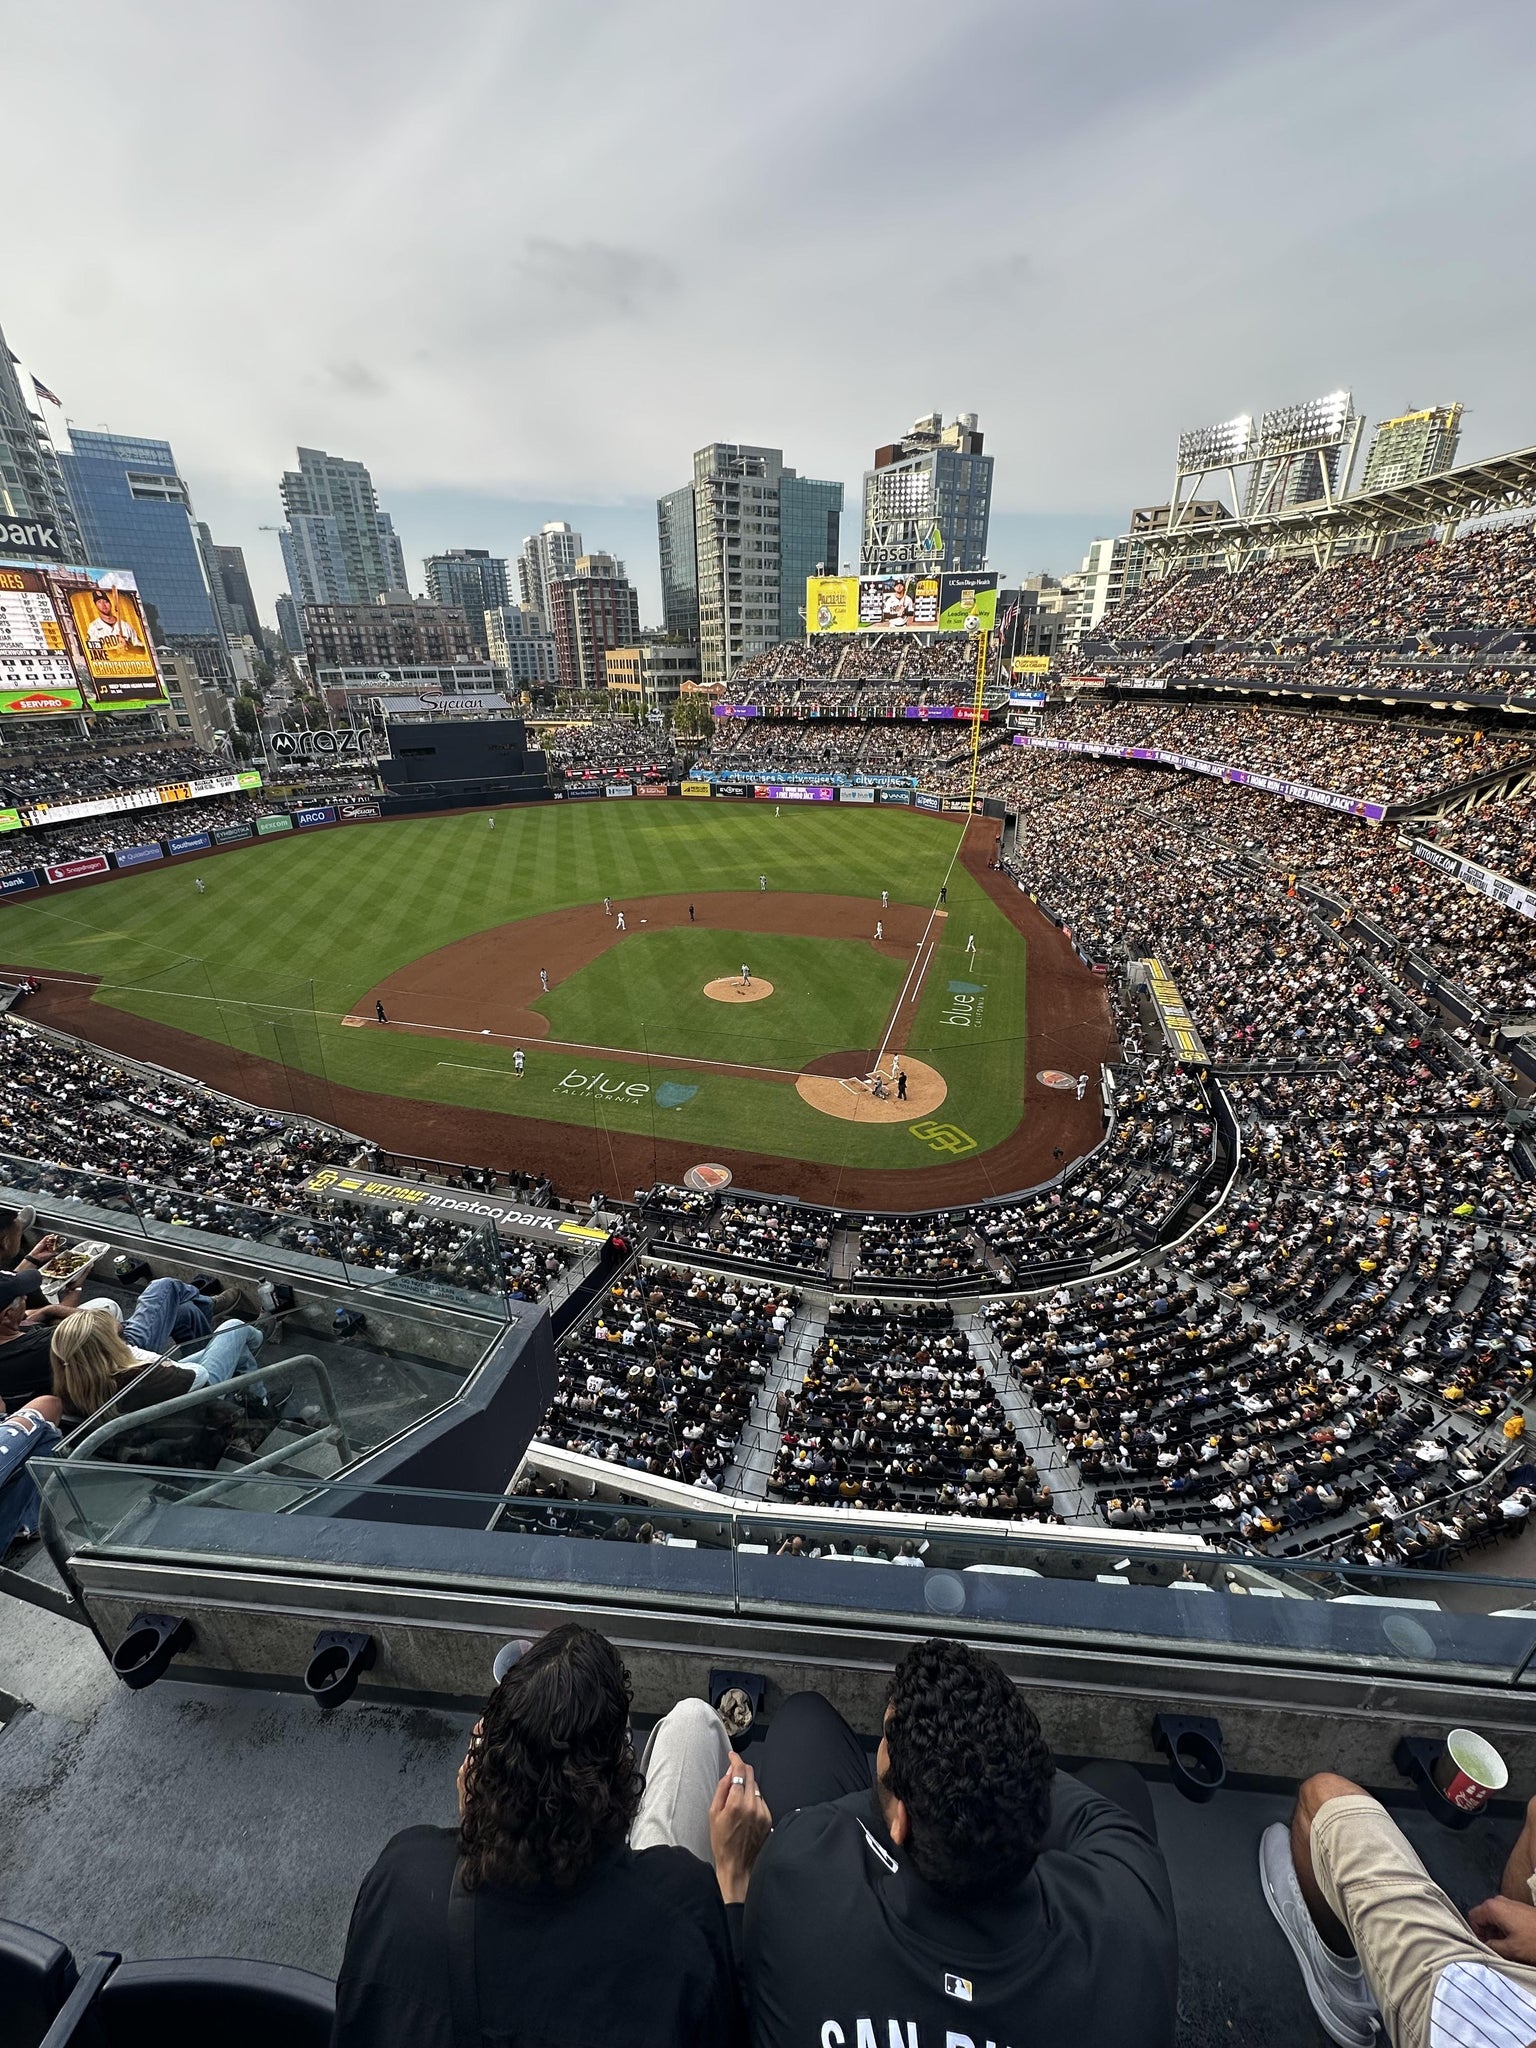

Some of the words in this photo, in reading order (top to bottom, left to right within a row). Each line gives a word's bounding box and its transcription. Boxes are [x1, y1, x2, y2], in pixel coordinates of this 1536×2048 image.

[862, 544, 918, 562] Viasat
[89, 650, 110, 660] JAKE
[20, 700, 62, 708] SERVPRO
[419, 691, 483, 715] Sycuan
[299, 728, 371, 754] razr
[1068, 742, 1082, 750] FREE
[1083, 744, 1104, 753] JUMBO
[184, 789, 190, 798] 2
[1250, 777, 1267, 788] HOME
[1267, 781, 1280, 792] RUN
[1285, 784, 1289, 794] 1
[1289, 786, 1306, 798] FREE
[1306, 790, 1331, 805] JUMBO
[300, 812, 325, 823] ARCO
[343, 806, 375, 817] Sycuan
[172, 839, 203, 850] Southwest
[1414, 844, 1457, 874] NITTOTIRE.COM
[66, 862, 101, 874] Snapdragon
[2, 877, 25, 888] bank
[939, 995, 975, 1027] blue
[974, 997, 985, 1028] CALIFORNIA
[558, 1069, 650, 1097] blue
[552, 1087, 639, 1104] CALIFORNIA
[363, 1182, 430, 1202] WELCOME
[439, 1198, 503, 1219] petco
[501, 1210, 560, 1231] park
[411, 1280, 423, 1288] NOT
